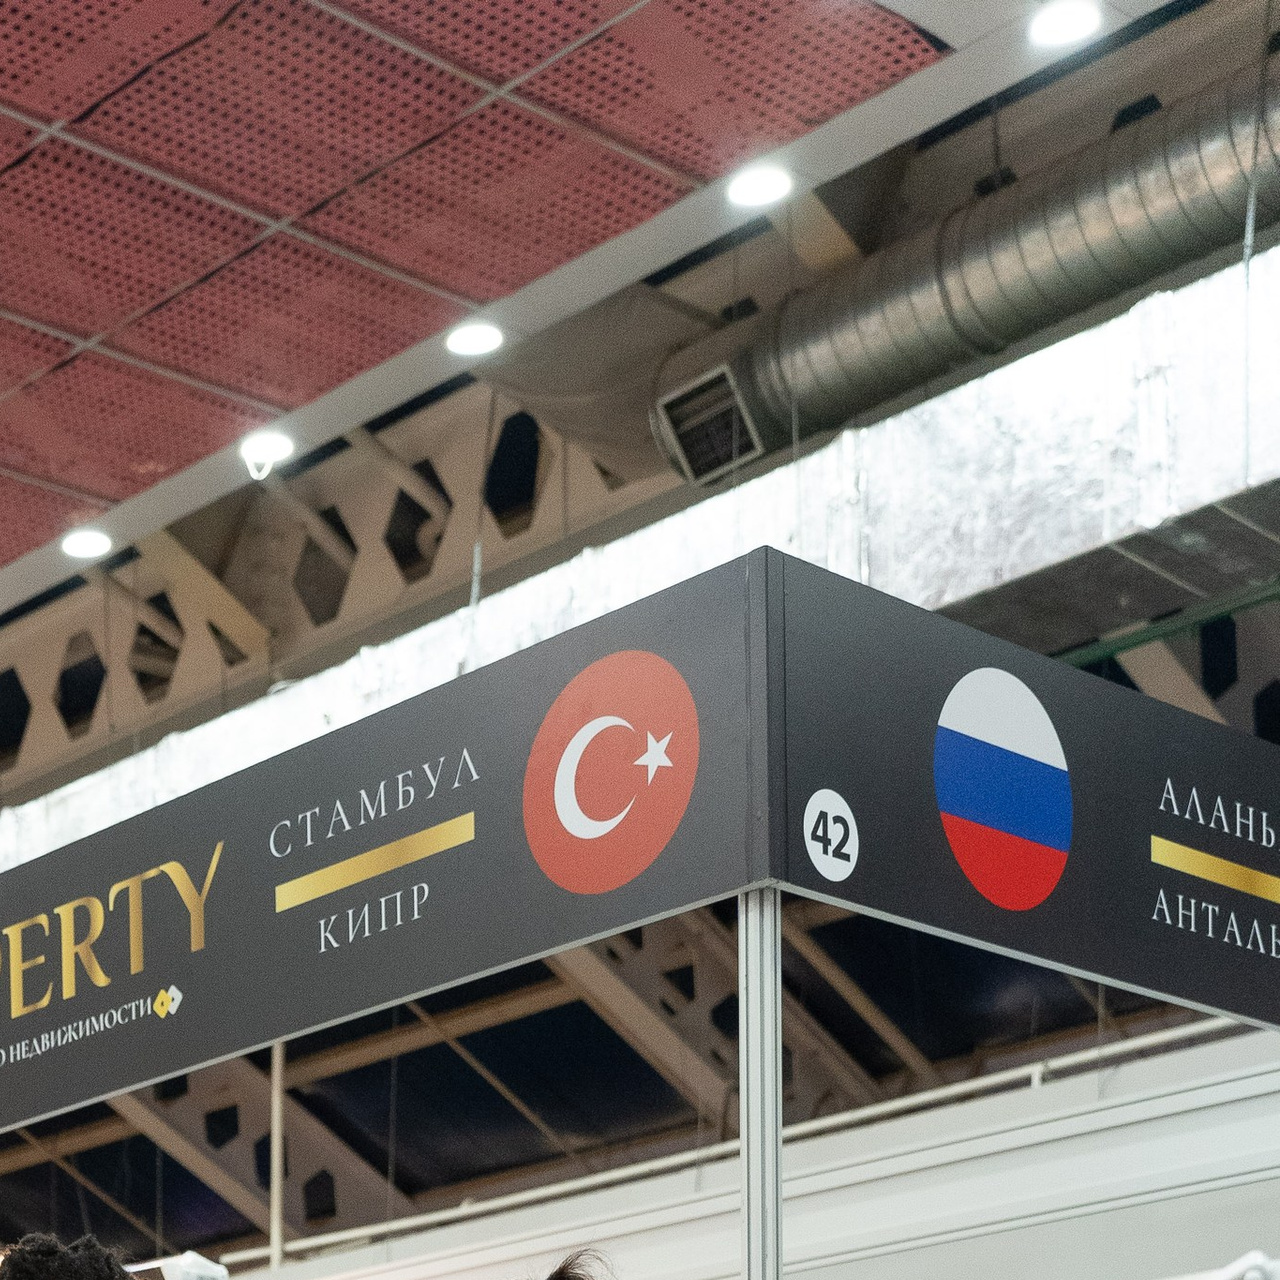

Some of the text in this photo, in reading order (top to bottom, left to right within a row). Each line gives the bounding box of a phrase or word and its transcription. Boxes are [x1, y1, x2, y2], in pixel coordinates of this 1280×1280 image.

[270, 747, 480, 858] СТАМБУЛ
[811, 810, 850, 863] 42
[1159, 777, 1280, 852] АЛАНЬ
[319, 882, 429, 953] КИПР
[9, 996, 152, 1063] НЕДВИЖИМОСТИ
